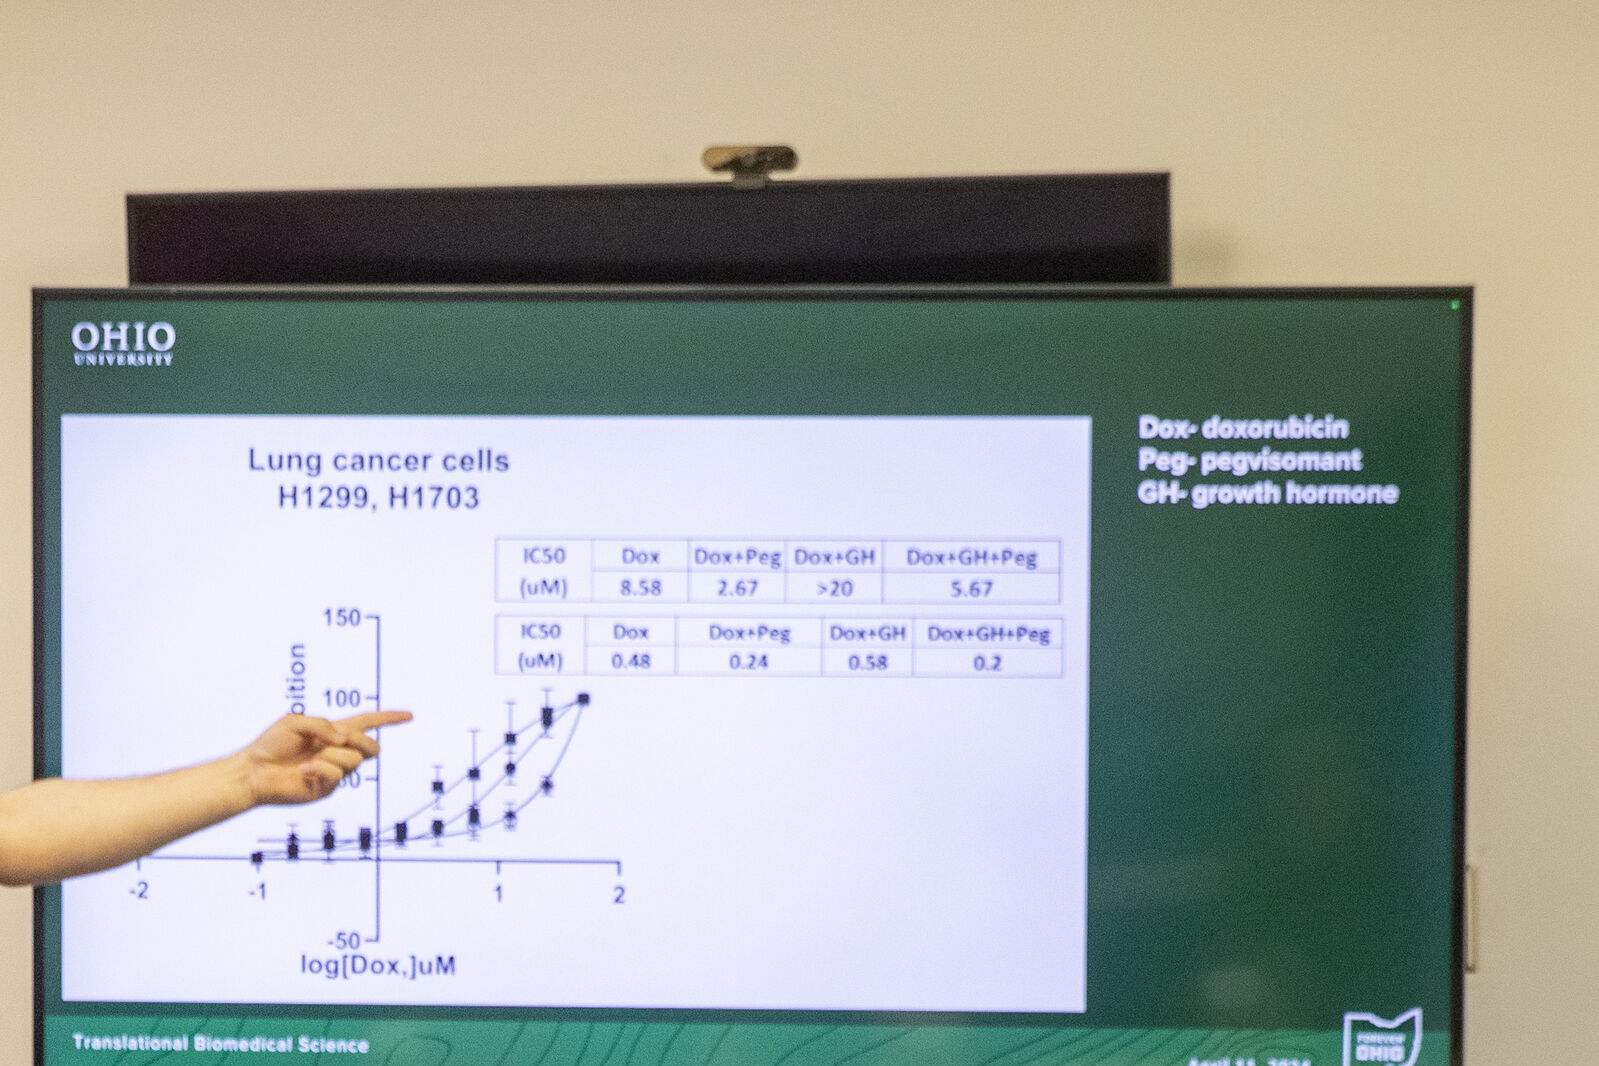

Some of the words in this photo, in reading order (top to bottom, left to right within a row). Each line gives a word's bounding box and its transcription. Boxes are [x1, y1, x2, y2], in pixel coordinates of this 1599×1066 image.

[71, 322, 176, 353] OHIO
[73, 351, 173, 367] UNIVERSITY
[1138, 414, 1199, 440] Dox-
[1201, 414, 1350, 440] doxorubicin
[248, 447, 322, 478] Lung
[332, 453, 433, 472] cancer
[441, 447, 510, 473] cells
[1138, 446, 1197, 477] Peg-
[1200, 446, 1363, 477] pegvisomant
[278, 484, 377, 512] H1299,
[388, 485, 480, 510] H1703
[1137, 479, 1188, 505] GH-
[1191, 480, 1282, 510] growth
[1285, 479, 1400, 505] hormone
[523, 545, 567, 565] IC50
[621, 546, 661, 565] Dox
[693, 547, 783, 571] Dox+Peg
[794, 547, 876, 566] Dox+GH
[906, 547, 1039, 572] Dox+GH+Peg
[519, 577, 569, 600] (uM)
[619, 578, 663, 597] 8.58
[717, 578, 760, 597] 2.67
[817, 578, 855, 598] >20
[950, 579, 994, 598] 5.67
[323, 606, 362, 627] 150
[520, 622, 563, 640] IC50
[612, 623, 650, 640] Dox
[708, 623, 792, 646] Dox+Peg
[829, 624, 907, 642] Dox+GH
[927, 624, 1052, 648] Dox+GH+Peg
[517, 651, 564, 673] (uM)
[611, 652, 652, 669] 0.48
[728, 653, 769, 670] 0.24
[847, 653, 889, 671] 0.58
[972, 653, 1003, 672] 0.2
[323, 688, 362, 708] 100
[129, 879, 149, 900] -2
[248, 881, 267, 901] -1
[494, 883, 503, 903] 1
[613, 884, 626, 905] 2
[327, 930, 362, 951] -50
[72, 1032, 189, 1052] Translational
[193, 1034, 294, 1053] Biomedical
[298, 1035, 370, 1054] Science
[1354, 1044, 1407, 1063] OHIO
